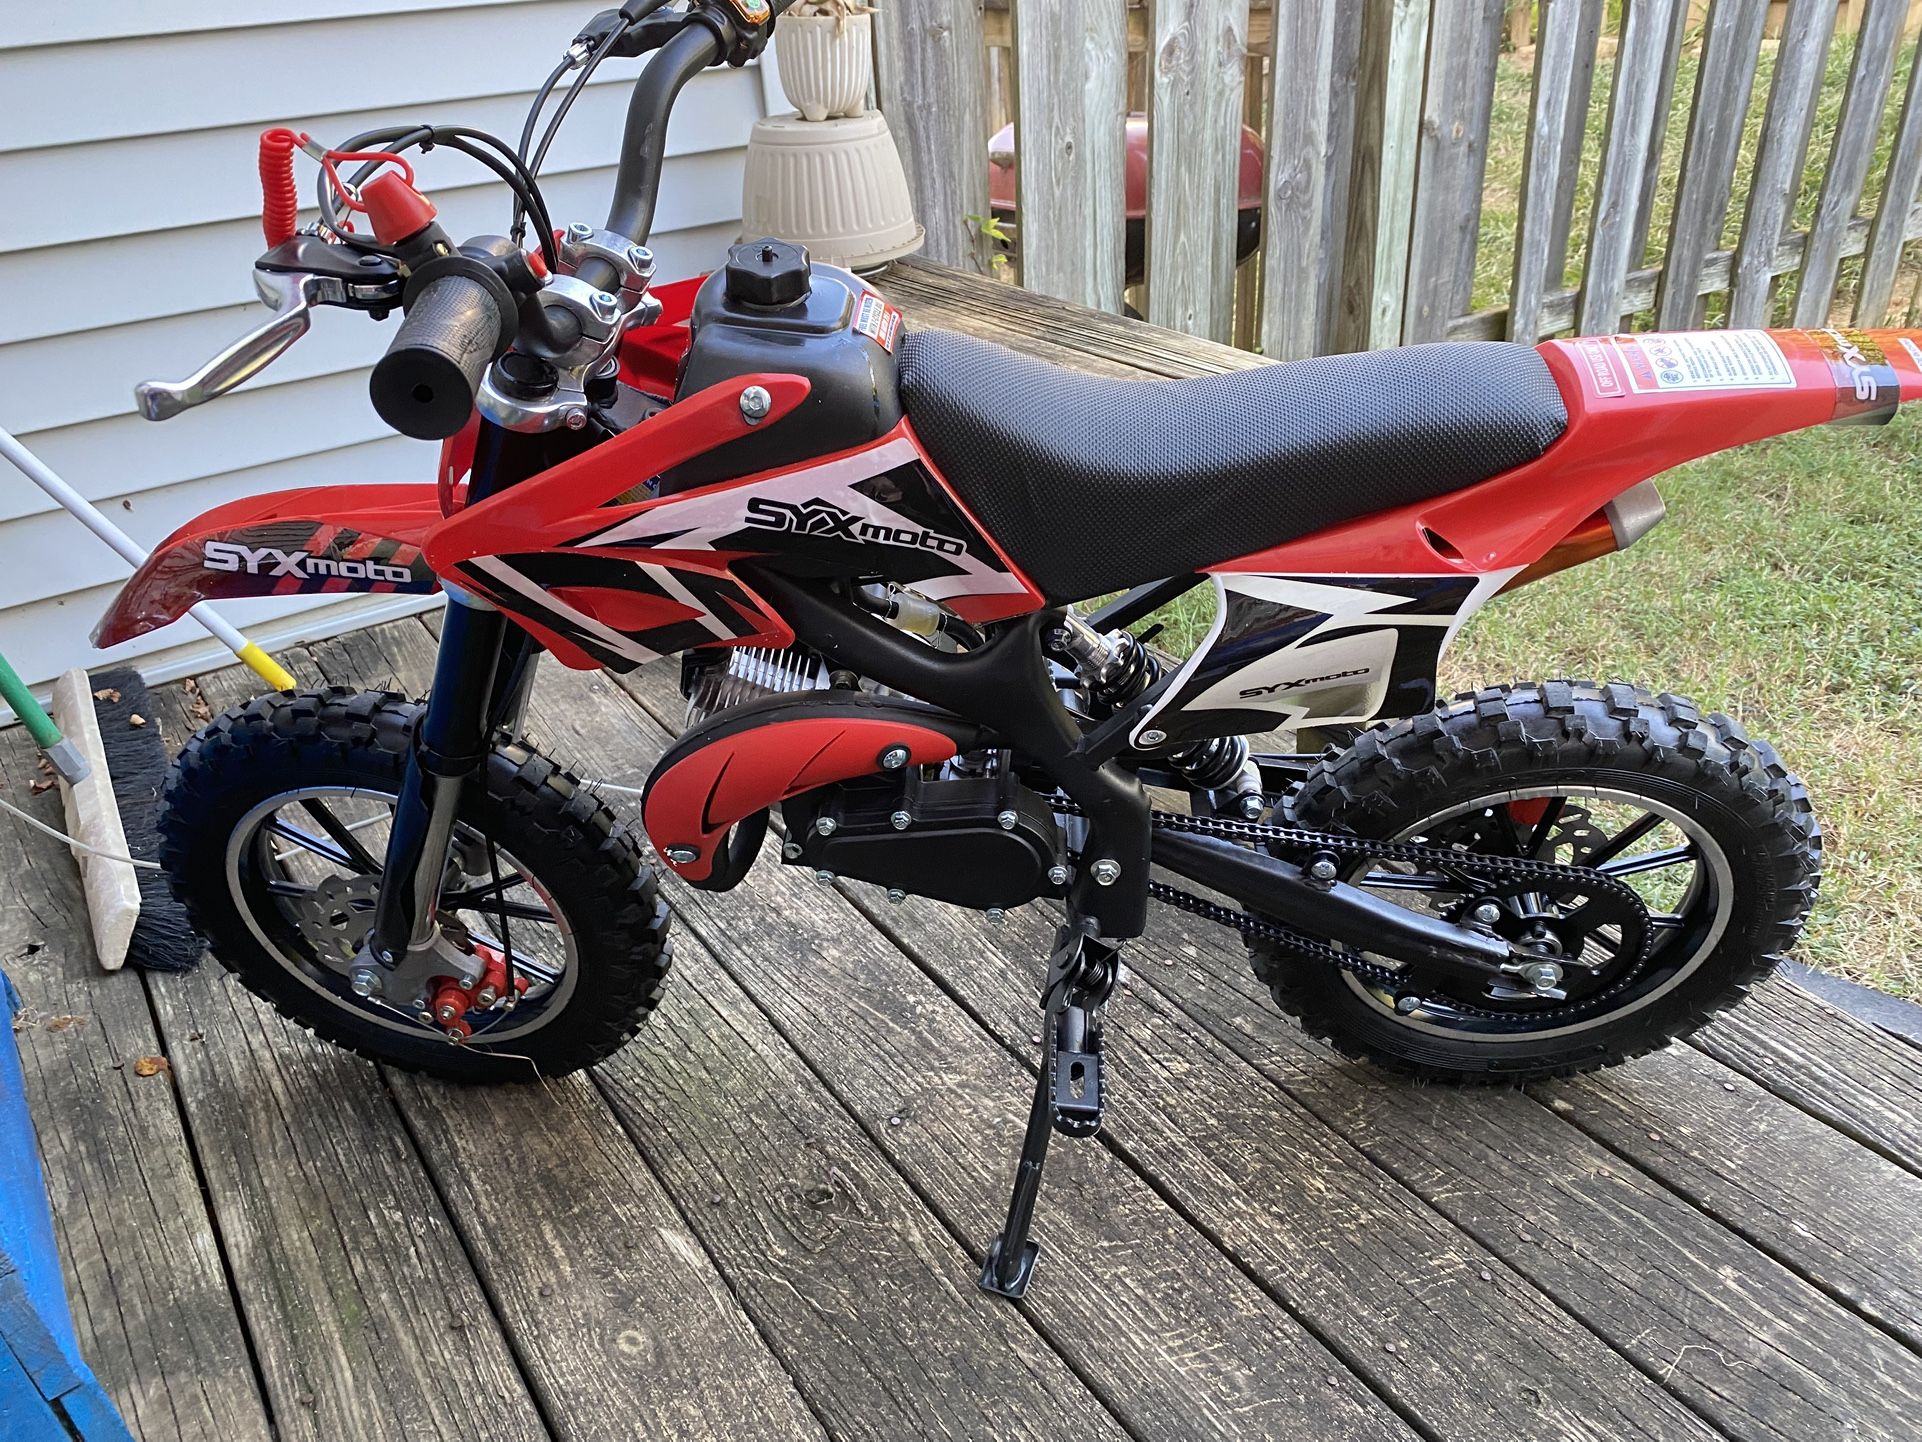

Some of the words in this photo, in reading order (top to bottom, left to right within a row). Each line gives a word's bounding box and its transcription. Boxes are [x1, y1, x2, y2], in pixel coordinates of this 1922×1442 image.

[744, 497, 967, 556] SYXmoto
[203, 540, 412, 583] SYXmoto
[1239, 667, 1370, 699] SYXmoto
